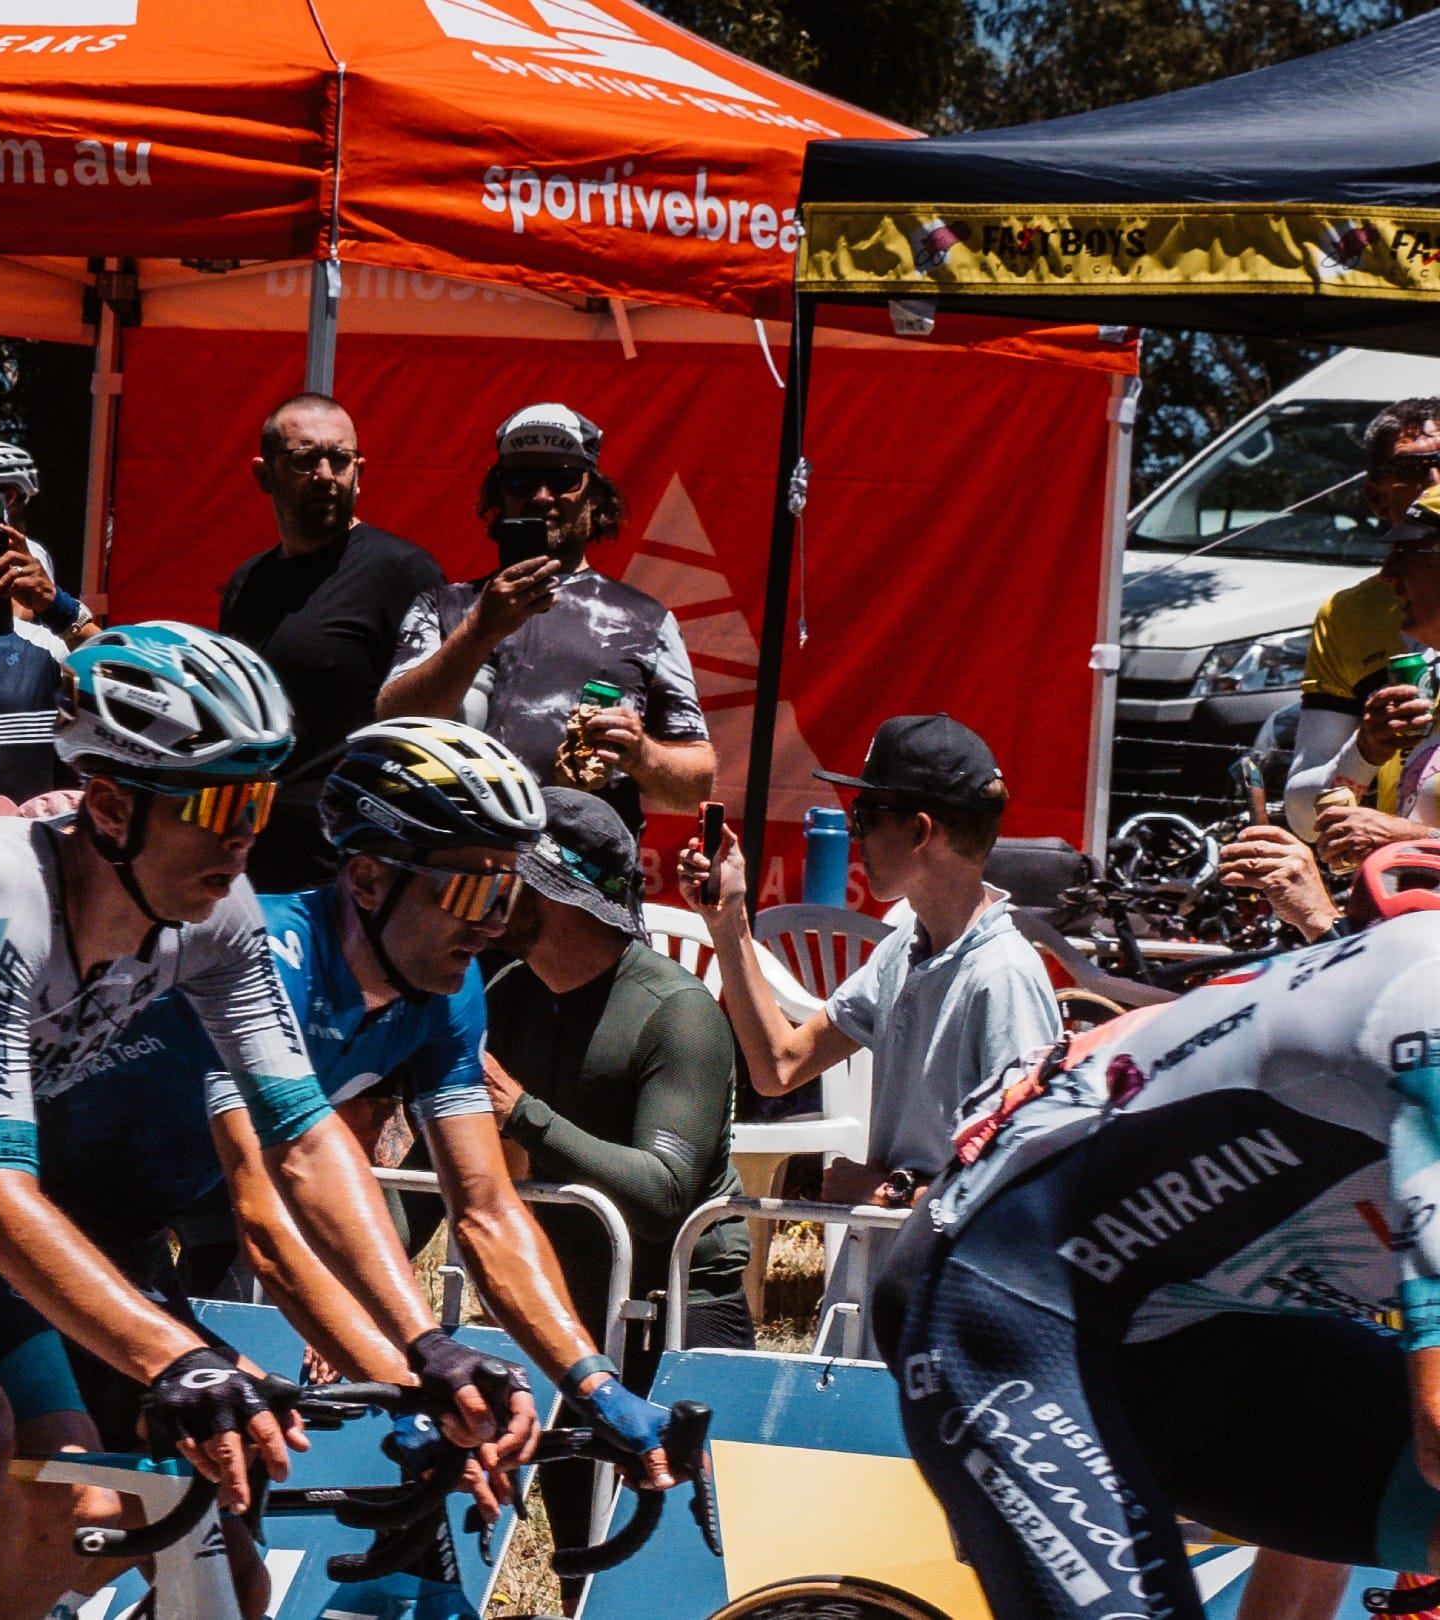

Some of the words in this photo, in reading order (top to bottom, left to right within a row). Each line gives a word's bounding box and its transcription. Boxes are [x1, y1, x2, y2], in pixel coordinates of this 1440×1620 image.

[472, 50, 683, 106] SPORTIVE
[116, 1033, 166, 1062] Tech
[1056, 1128, 1303, 1283] BAHRAIN
